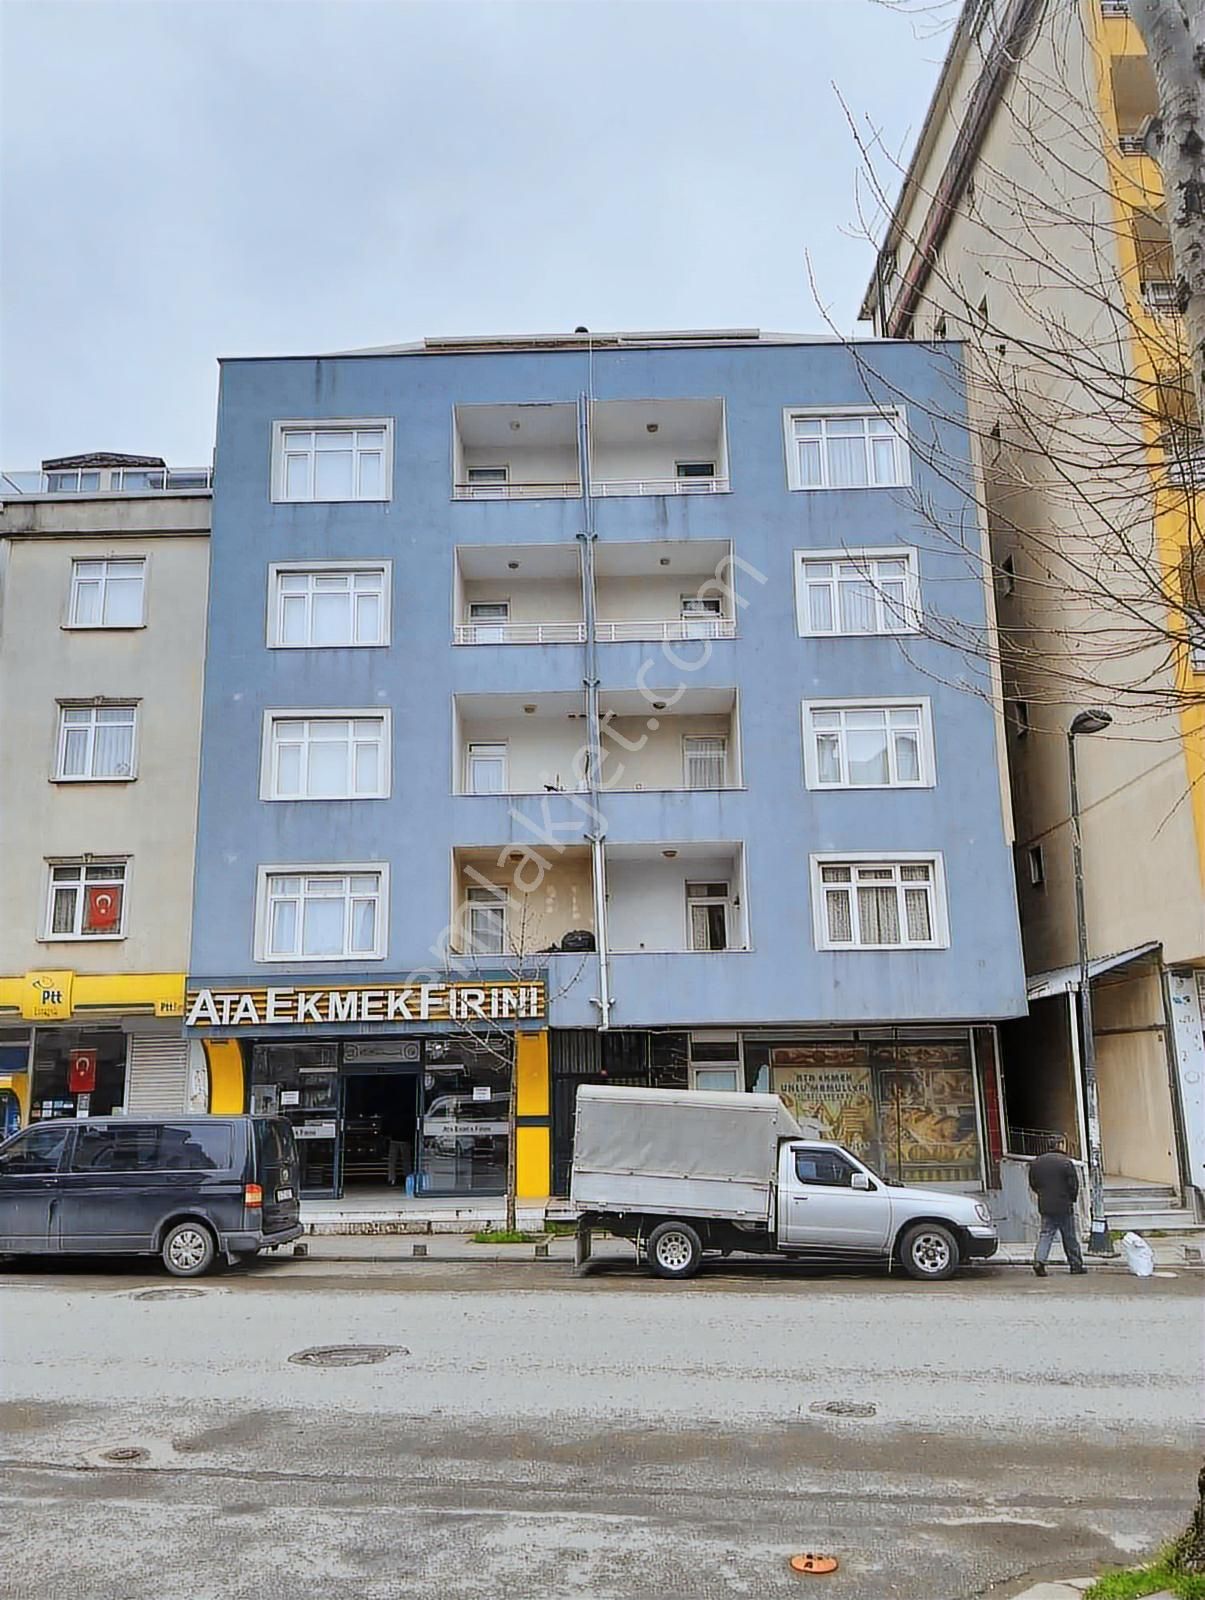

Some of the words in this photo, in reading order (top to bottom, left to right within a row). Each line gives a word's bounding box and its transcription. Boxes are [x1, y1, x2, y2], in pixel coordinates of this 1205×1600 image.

[42, 990, 63, 1005] Ptt
[185, 988, 261, 1025] ATA
[265, 986, 413, 1024] EKMEK
